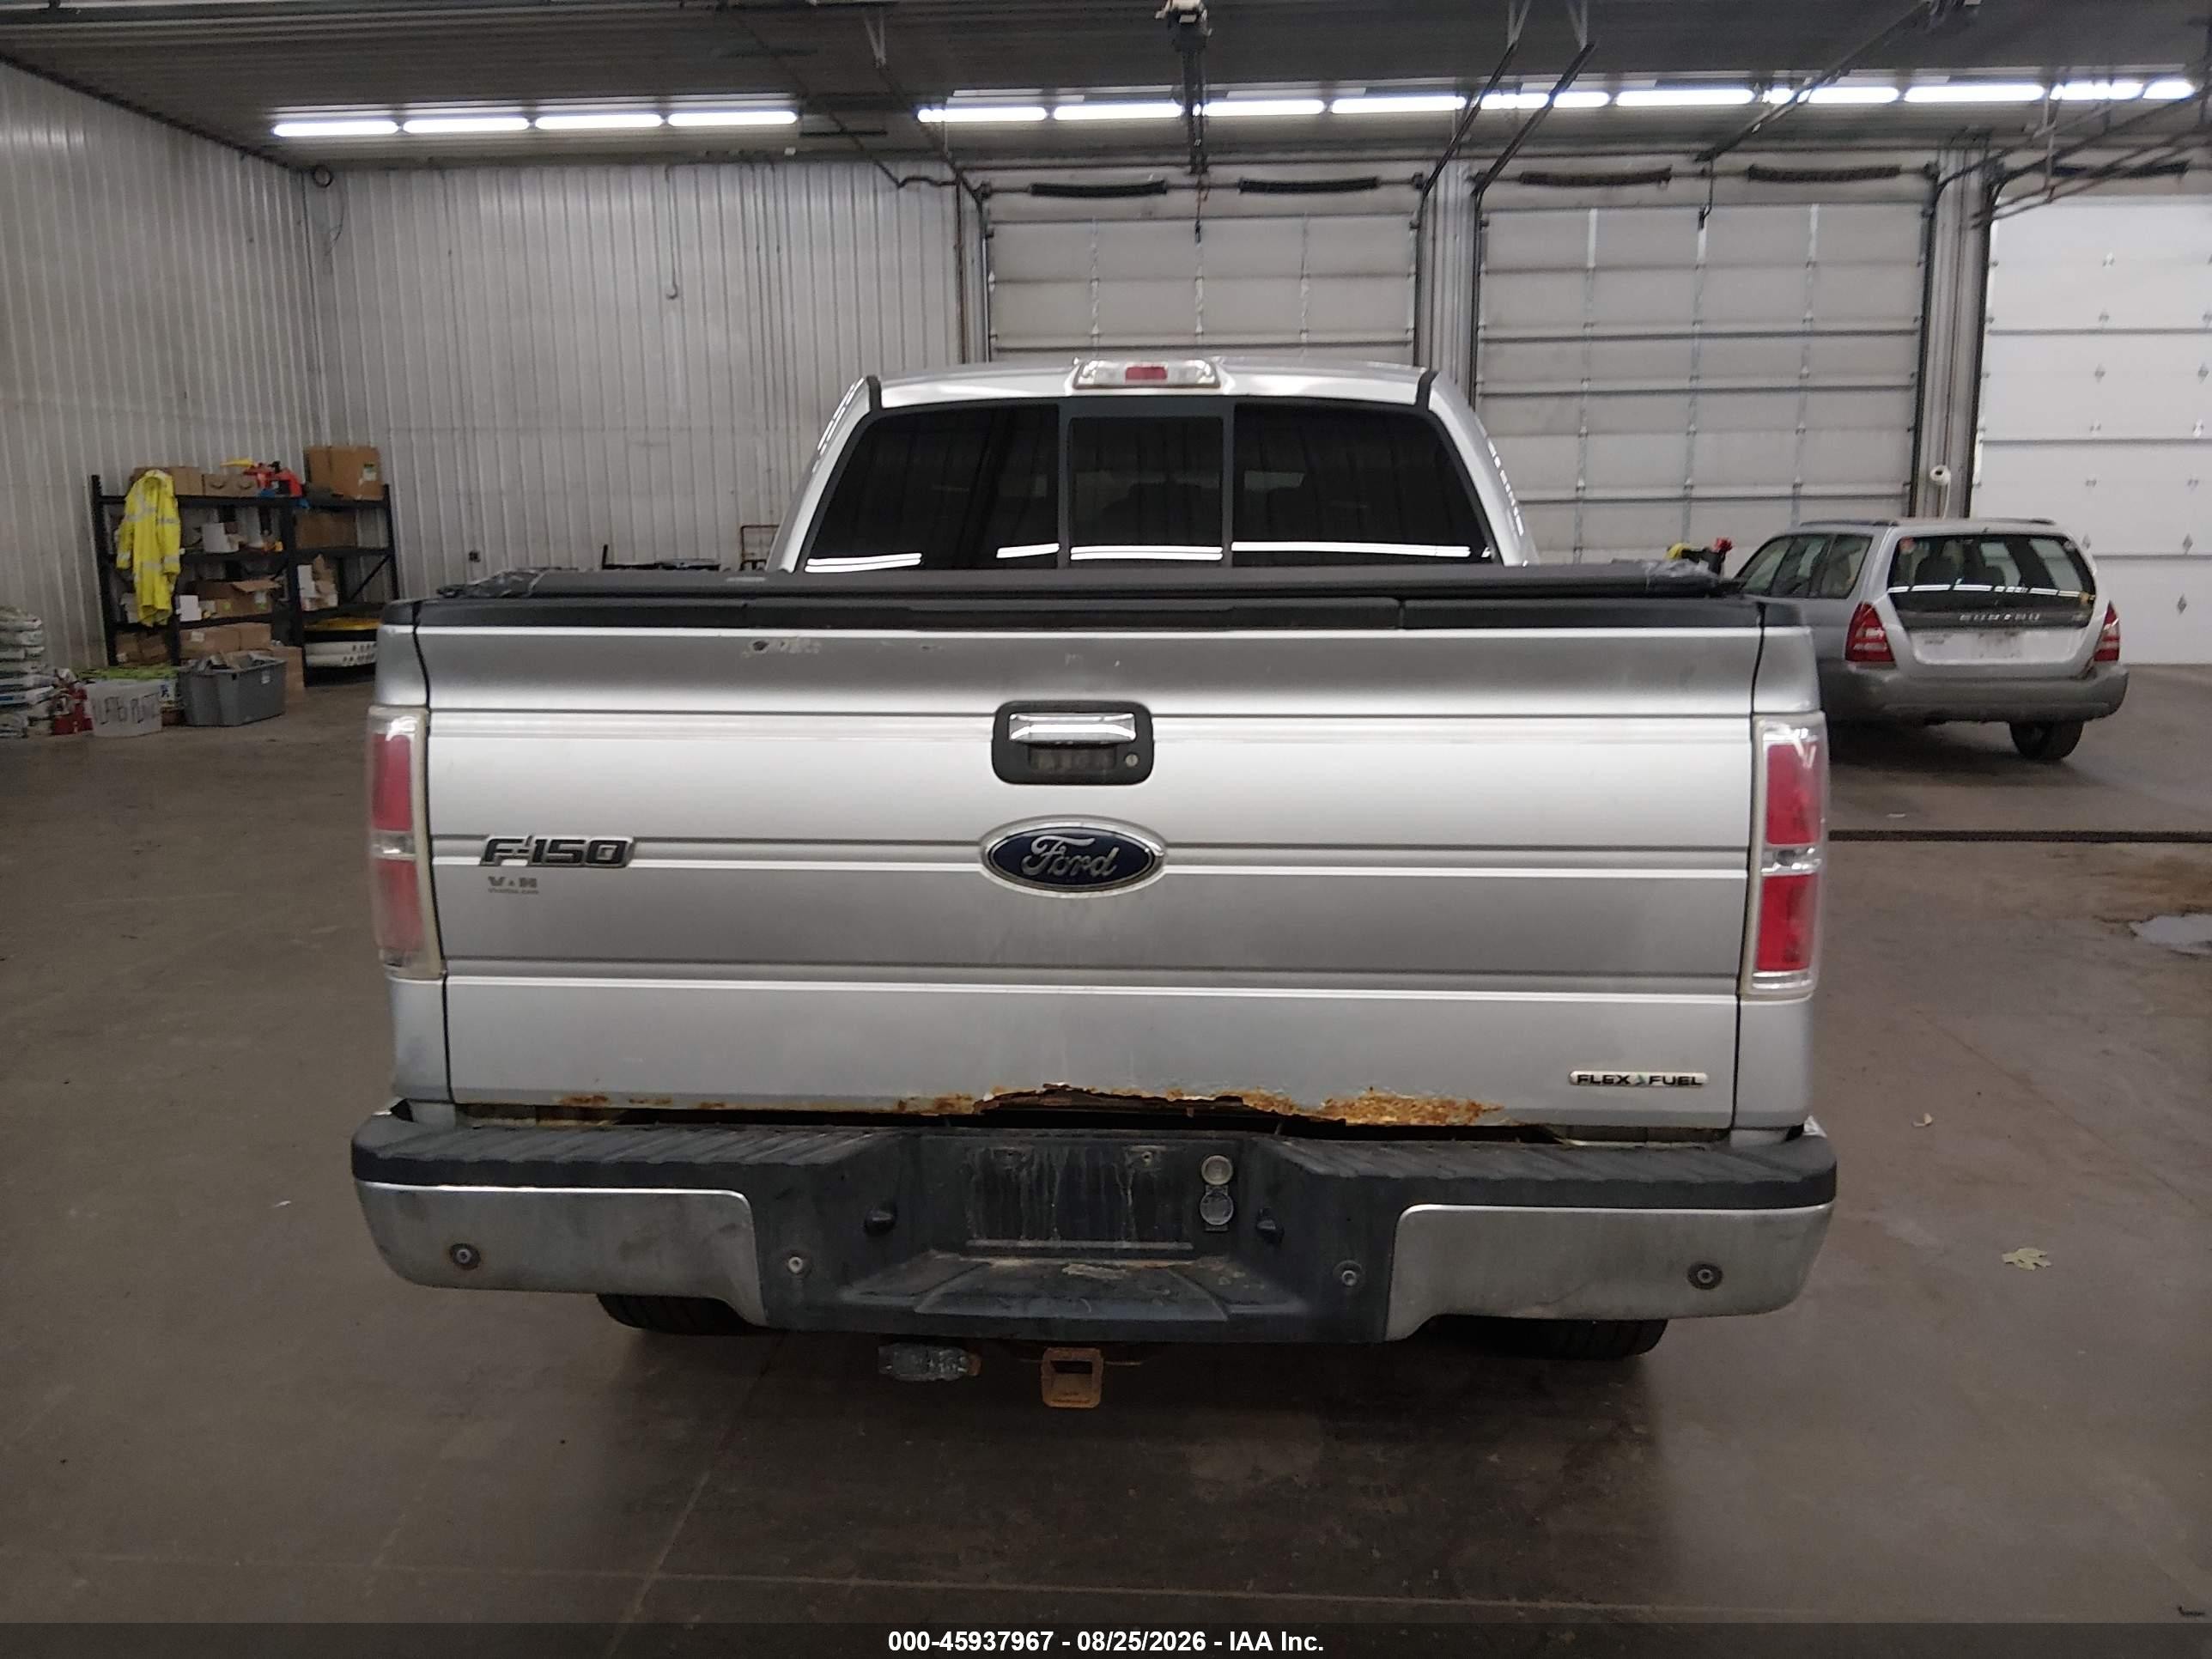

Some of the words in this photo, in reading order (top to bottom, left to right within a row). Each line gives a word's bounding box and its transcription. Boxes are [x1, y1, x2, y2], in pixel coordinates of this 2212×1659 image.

[479, 836, 633, 867] F-150
[1021, 835, 1120, 878] Ford
[1577, 1074, 1631, 1085] FLEX
[1648, 1075, 1703, 1086] FUEL
